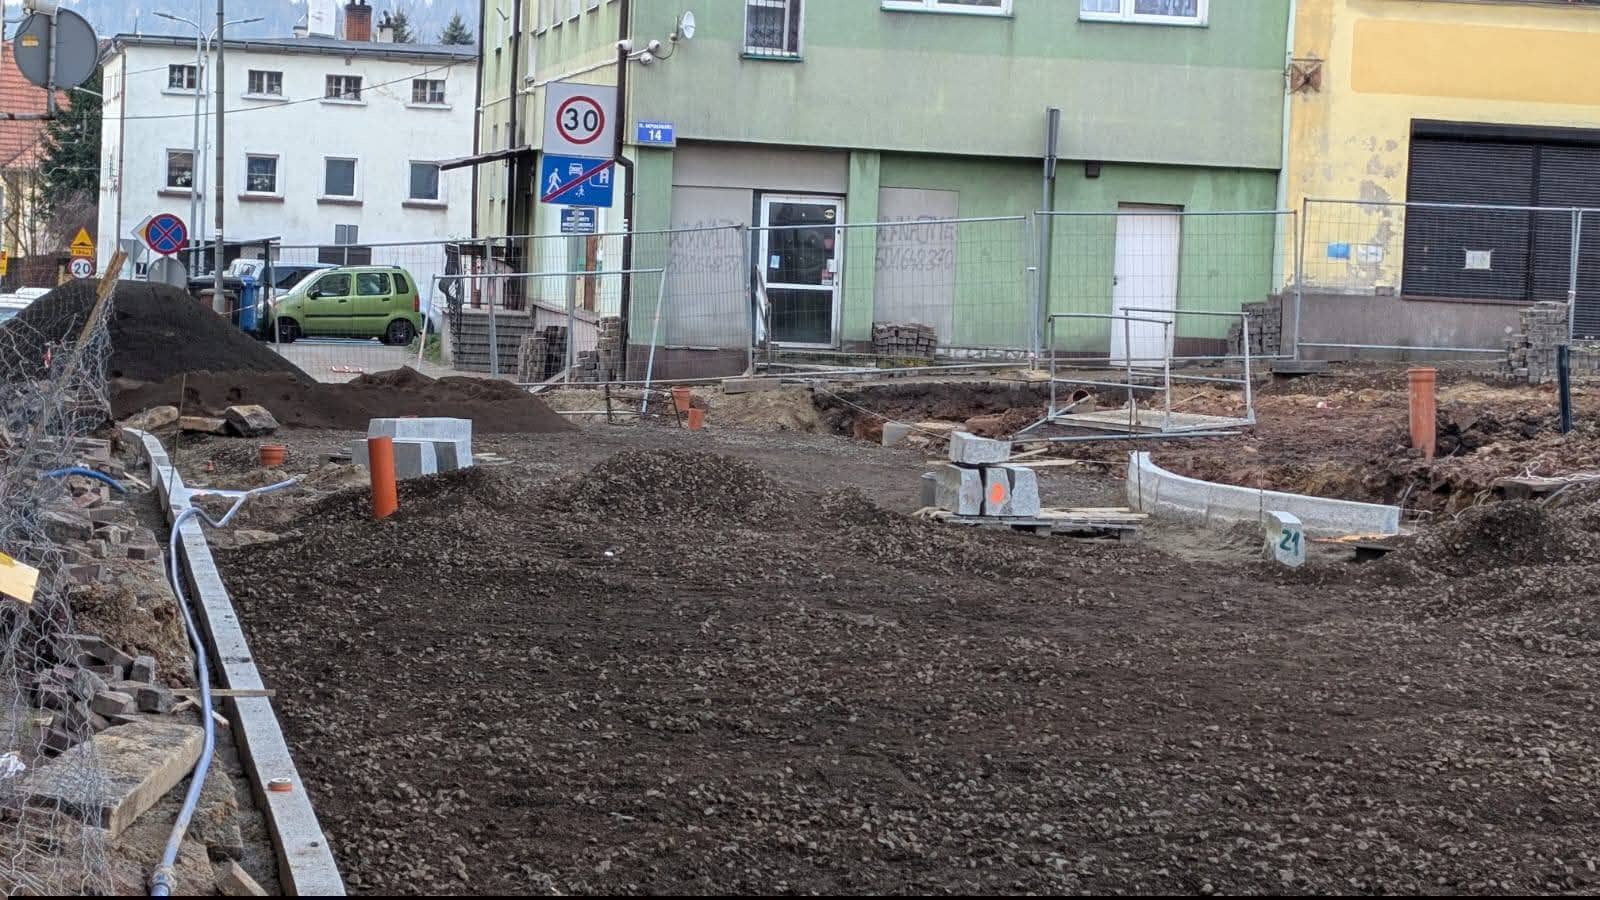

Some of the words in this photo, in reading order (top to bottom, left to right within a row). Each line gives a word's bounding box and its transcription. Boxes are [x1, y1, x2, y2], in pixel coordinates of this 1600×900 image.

[564, 108, 598, 132] 30
[648, 129, 662, 141] 14
[74, 263, 91, 274] 20
[1279, 528, 1300, 556] 21
